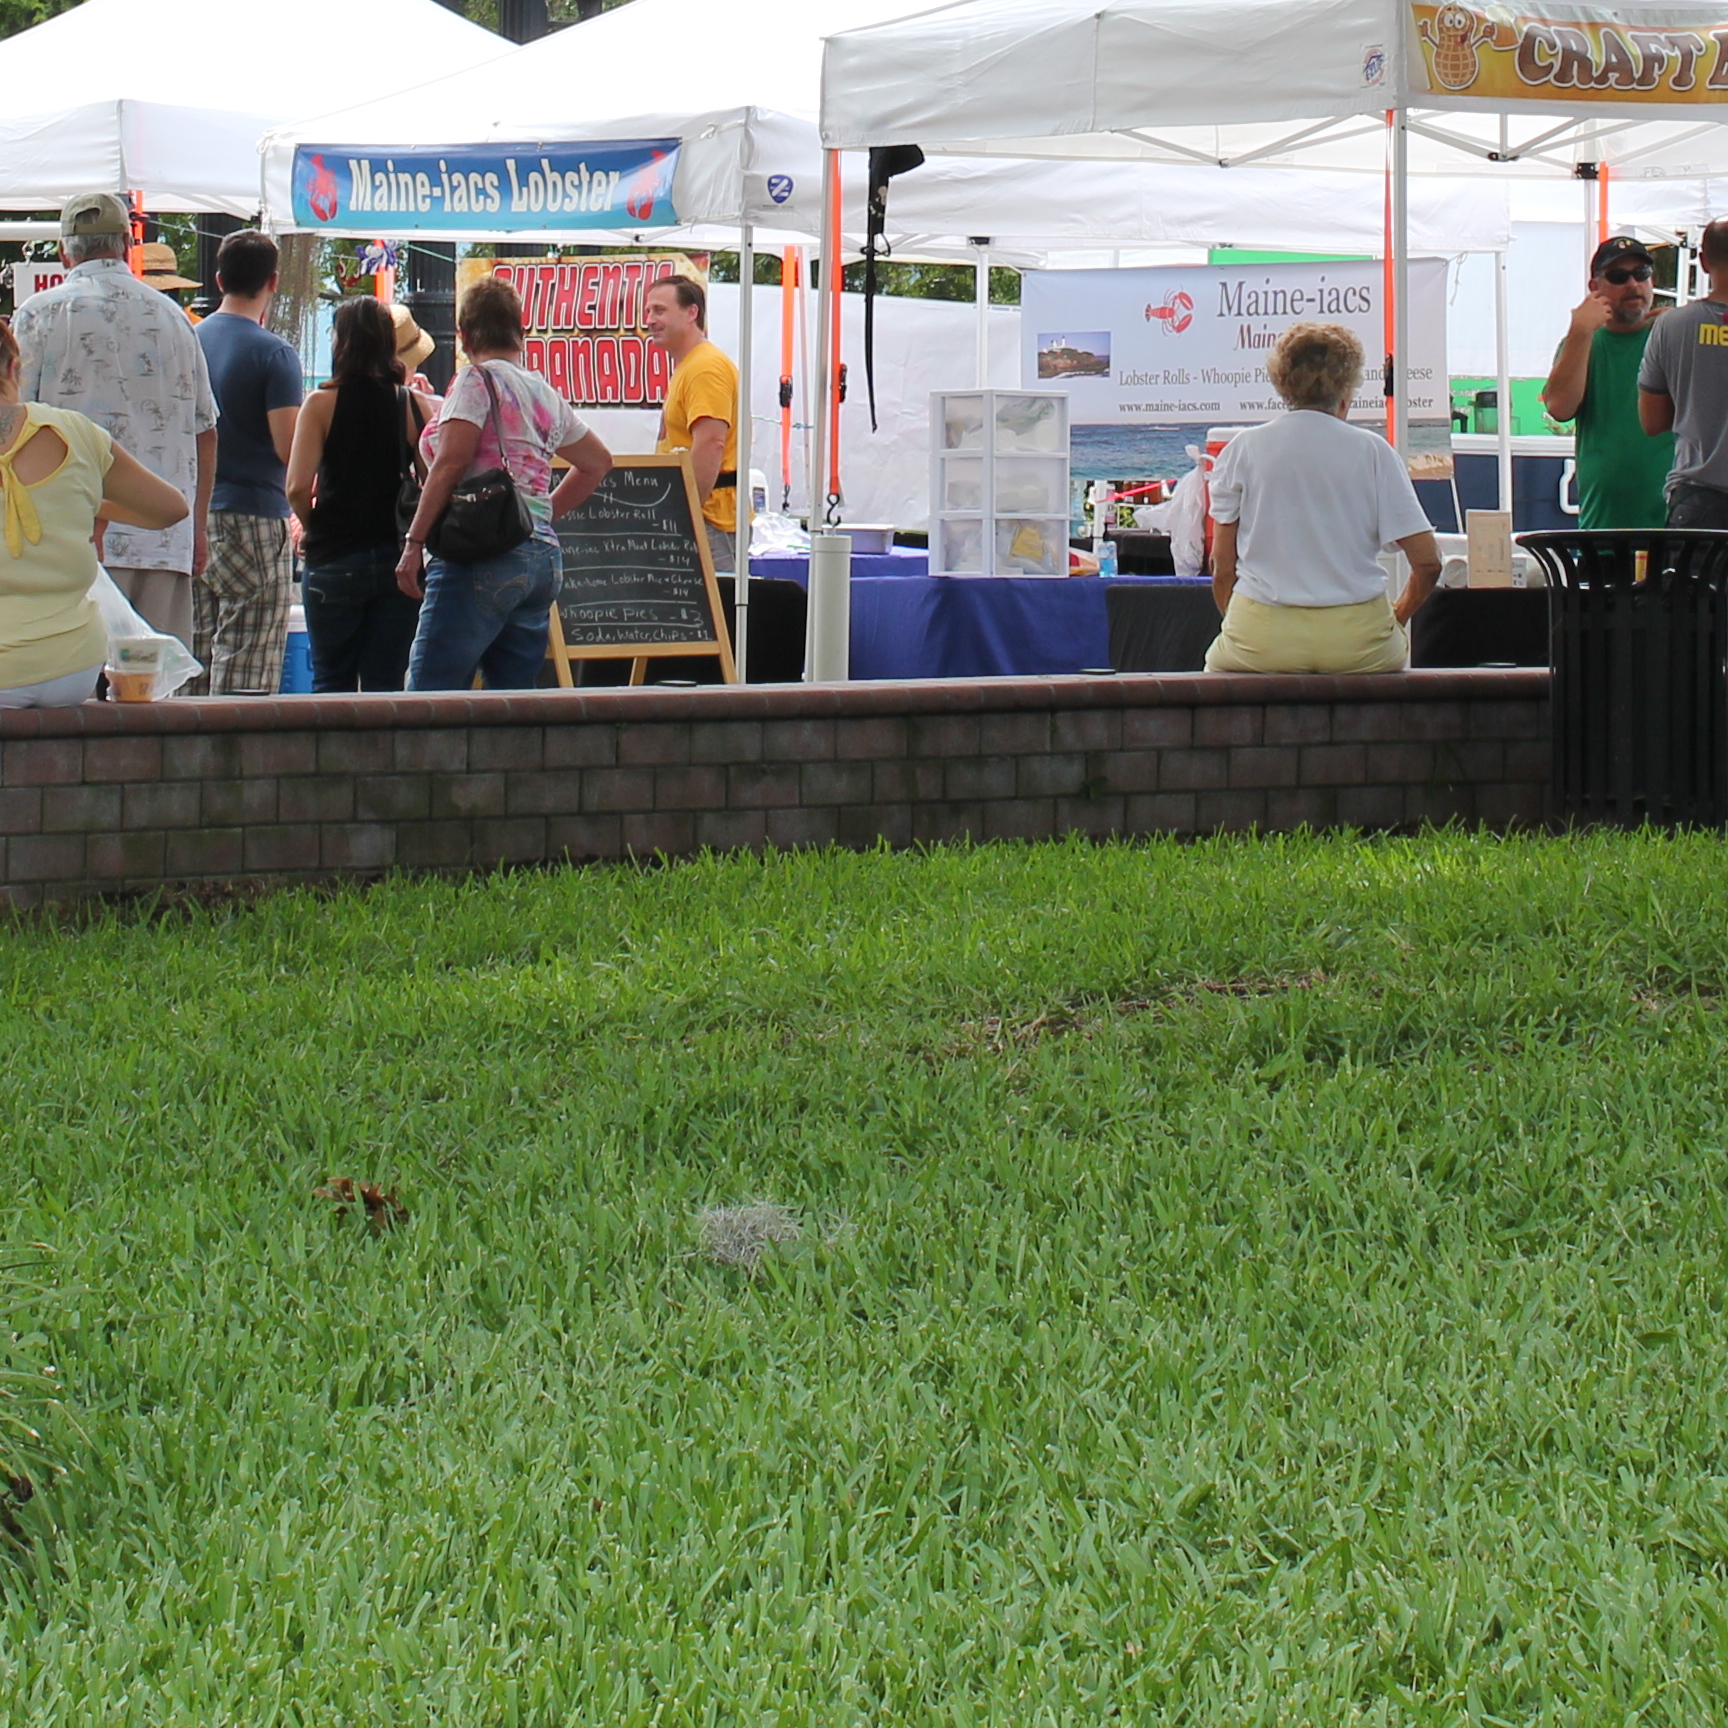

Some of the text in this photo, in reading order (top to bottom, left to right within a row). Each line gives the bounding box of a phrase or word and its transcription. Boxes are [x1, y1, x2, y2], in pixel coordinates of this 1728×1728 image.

[1516, 23, 1703, 92] CRAFT
[348, 158, 621, 213] Maine-iacs Lobster
[493, 261, 674, 330] UTHENTI
[1217, 275, 1371, 318] Maine-iacs
[1119, 370, 1160, 386] Lobster
[1163, 368, 1190, 385] Rolls
[1201, 367, 1251, 388] Whoopie
[624, 471, 659, 488] Menu
[589, 507, 629, 519] Lobster
